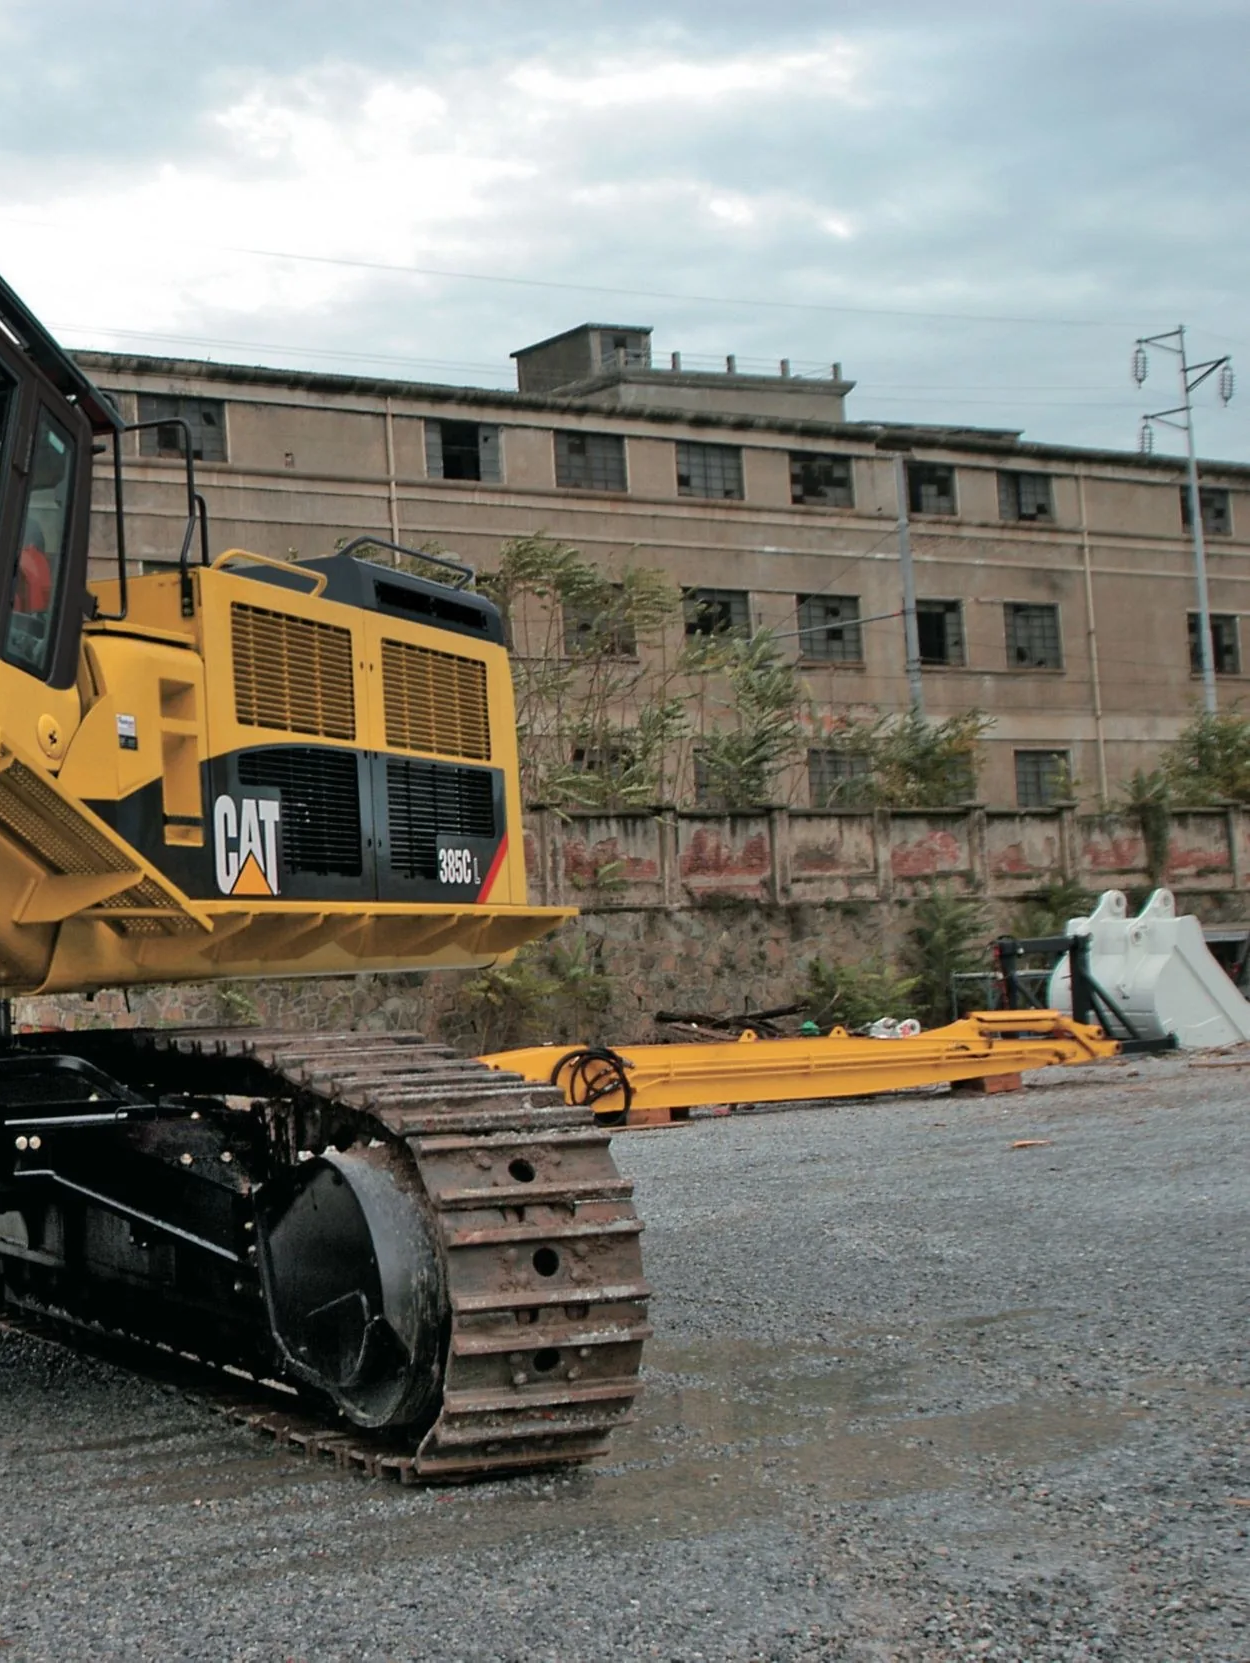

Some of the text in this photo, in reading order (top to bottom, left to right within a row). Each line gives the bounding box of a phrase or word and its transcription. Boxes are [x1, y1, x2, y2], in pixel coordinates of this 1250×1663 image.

[214, 794, 280, 896] CAT
[439, 848, 481, 884] 385C L
